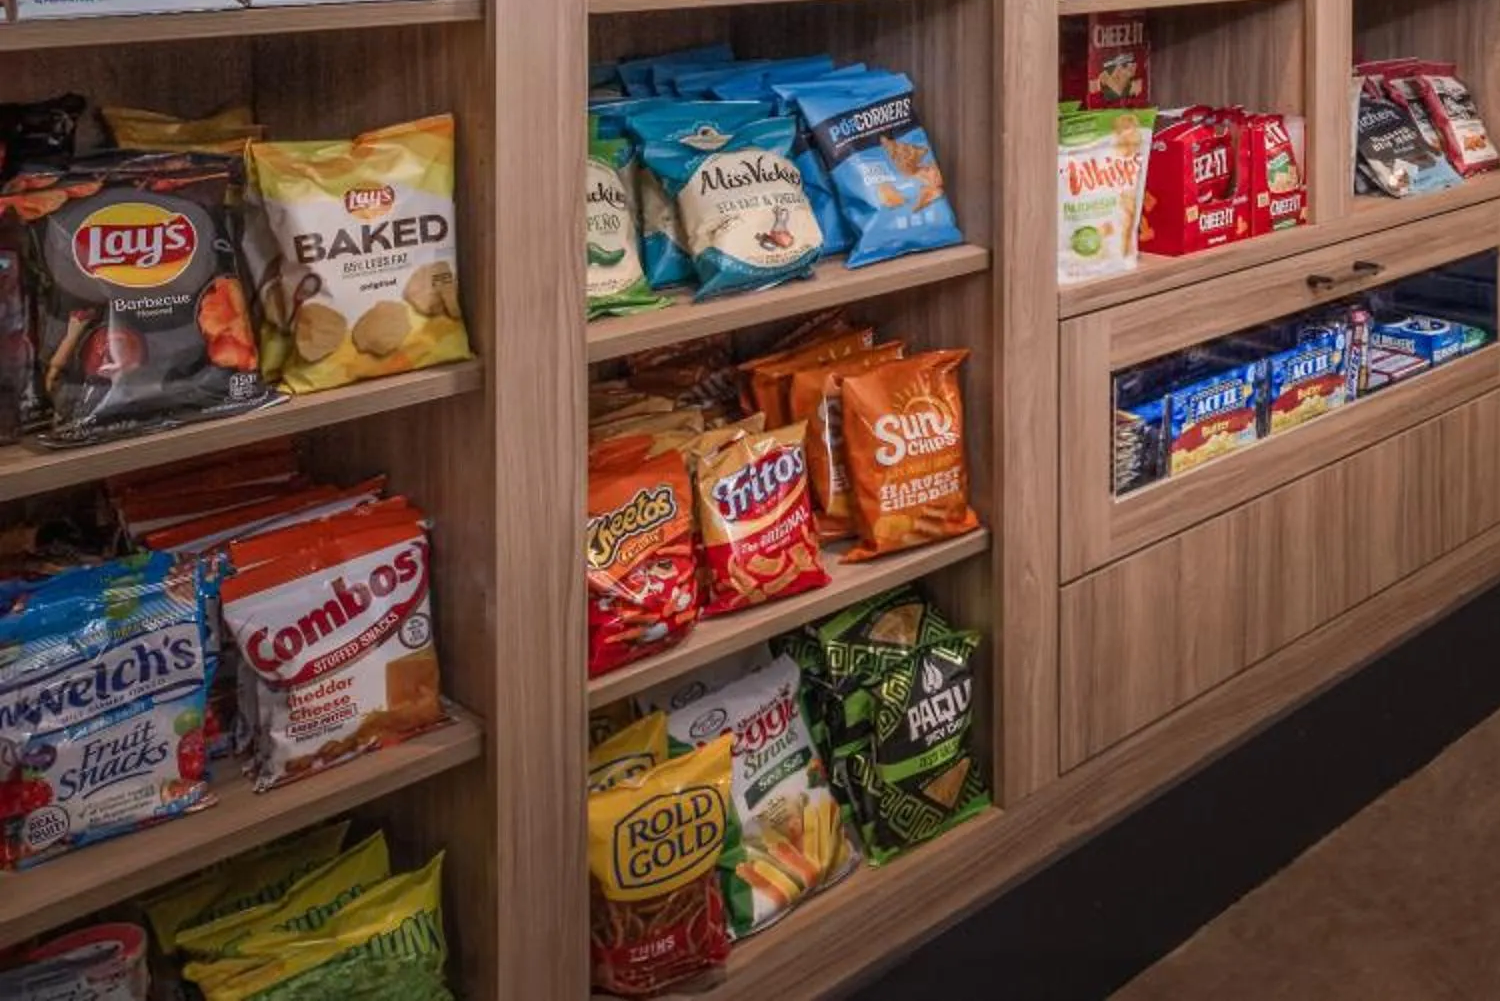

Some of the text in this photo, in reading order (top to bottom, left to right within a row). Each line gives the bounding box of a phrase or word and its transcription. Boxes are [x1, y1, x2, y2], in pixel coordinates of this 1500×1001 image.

[1093, 22, 1144, 49] CHEEZ-IT
[350, 186, 392, 210] Lay's
[702, 167, 750, 195] Miss
[1067, 153, 1142, 196] Whisps
[293, 215, 449, 264] BAKED
[588, 213, 621, 233] PEÑO
[1199, 206, 1234, 232] CHEEZ-IT
[88, 224, 188, 268] Lay's
[114, 294, 191, 312] Barbecue
[875, 411, 953, 466] Sun
[907, 433, 959, 456] CHIPS
[712, 446, 804, 521] Fritos
[880, 466, 961, 500] HARVEST
[587, 490, 673, 565] Cheetos
[247, 550, 418, 672] Combos
[313, 613, 399, 674] STUFFED SNACKS
[20, 637, 197, 726] Welch's
[908, 678, 972, 742] PAQU
[57, 740, 169, 801] Snacks
[82, 721, 157, 771] Fruit
[628, 794, 713, 848] ROLD
[629, 821, 718, 879] GOLD
[629, 936, 676, 962] THINS
